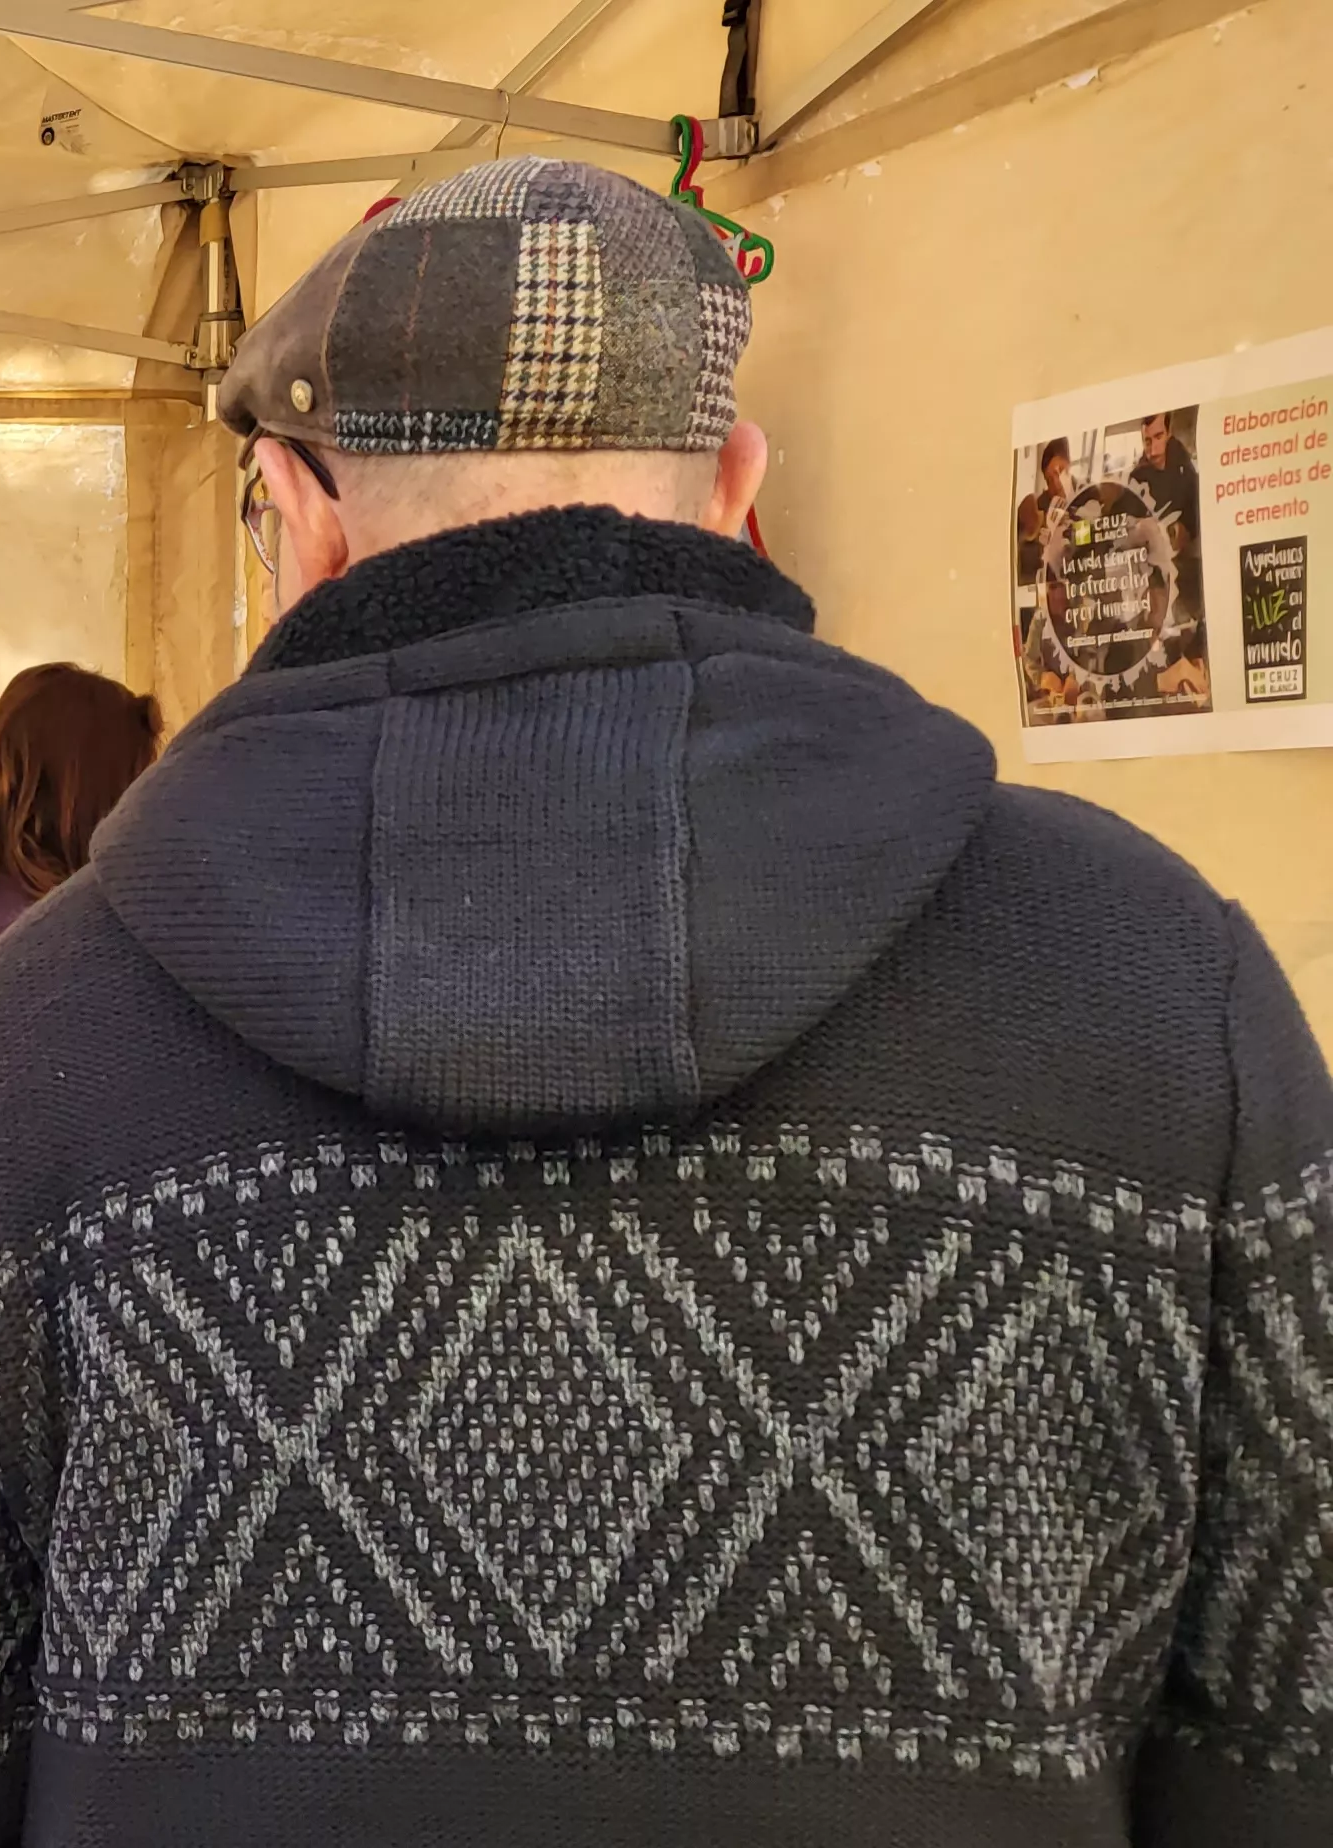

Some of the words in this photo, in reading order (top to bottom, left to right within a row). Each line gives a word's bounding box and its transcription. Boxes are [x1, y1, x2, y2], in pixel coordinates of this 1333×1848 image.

[1223, 395, 1328, 435] Elaboración
[1220, 432, 1298, 466] artesanal
[1304, 429, 1328, 450] de
[1216, 467, 1302, 504] portavelas
[1308, 460, 1332, 481] de
[1094, 513, 1127, 531] CRUZ
[1235, 496, 1309, 526] cemento
[1095, 527, 1128, 543] BLANCA
[1078, 549, 1102, 573] vida
[1065, 591, 1151, 629] oportunidad
[1247, 631, 1302, 665] mundo
[1269, 669, 1298, 683] CRUZ
